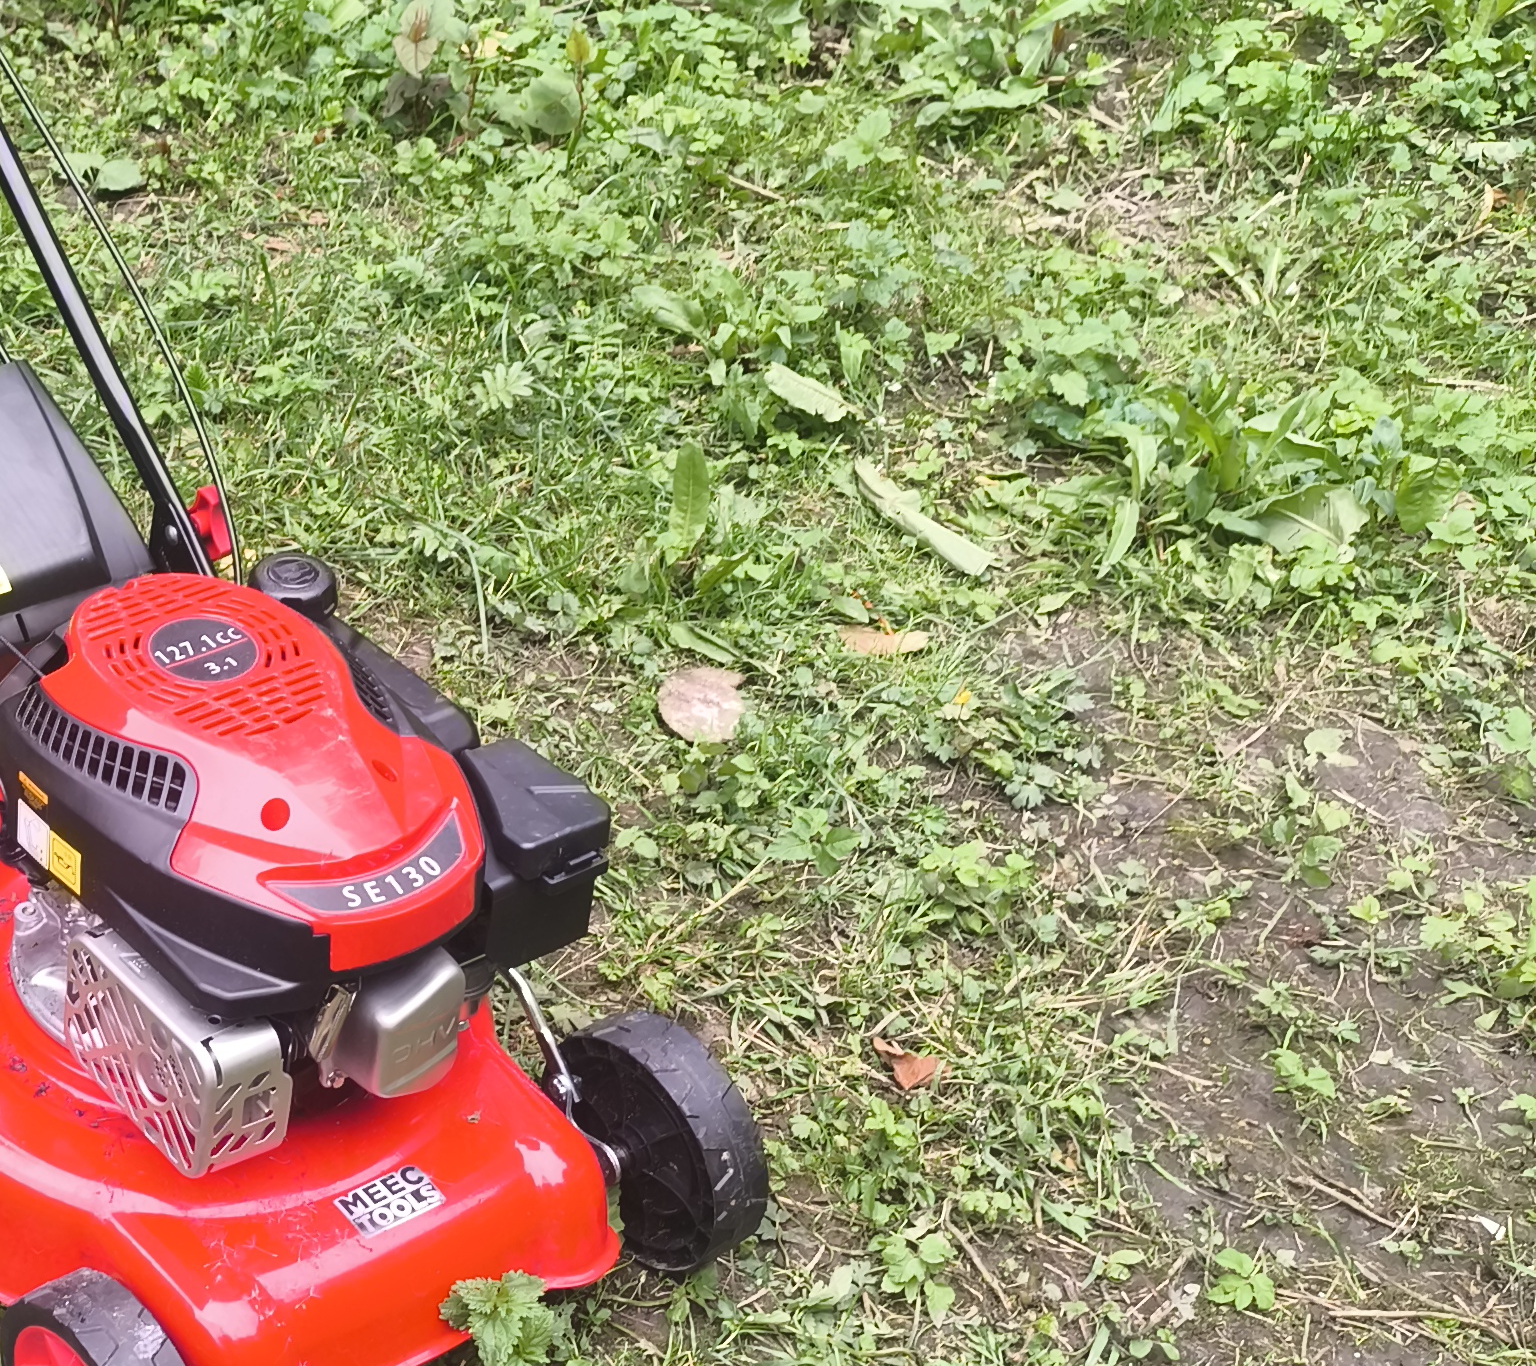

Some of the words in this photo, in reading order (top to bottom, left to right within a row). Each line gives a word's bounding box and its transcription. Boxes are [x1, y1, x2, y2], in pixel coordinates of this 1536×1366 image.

[203, 655, 238, 675] 3.1
[342, 856, 442, 908] SE130
[338, 1166, 425, 1216] MEEC
[355, 1184, 442, 1234] TOOLS
